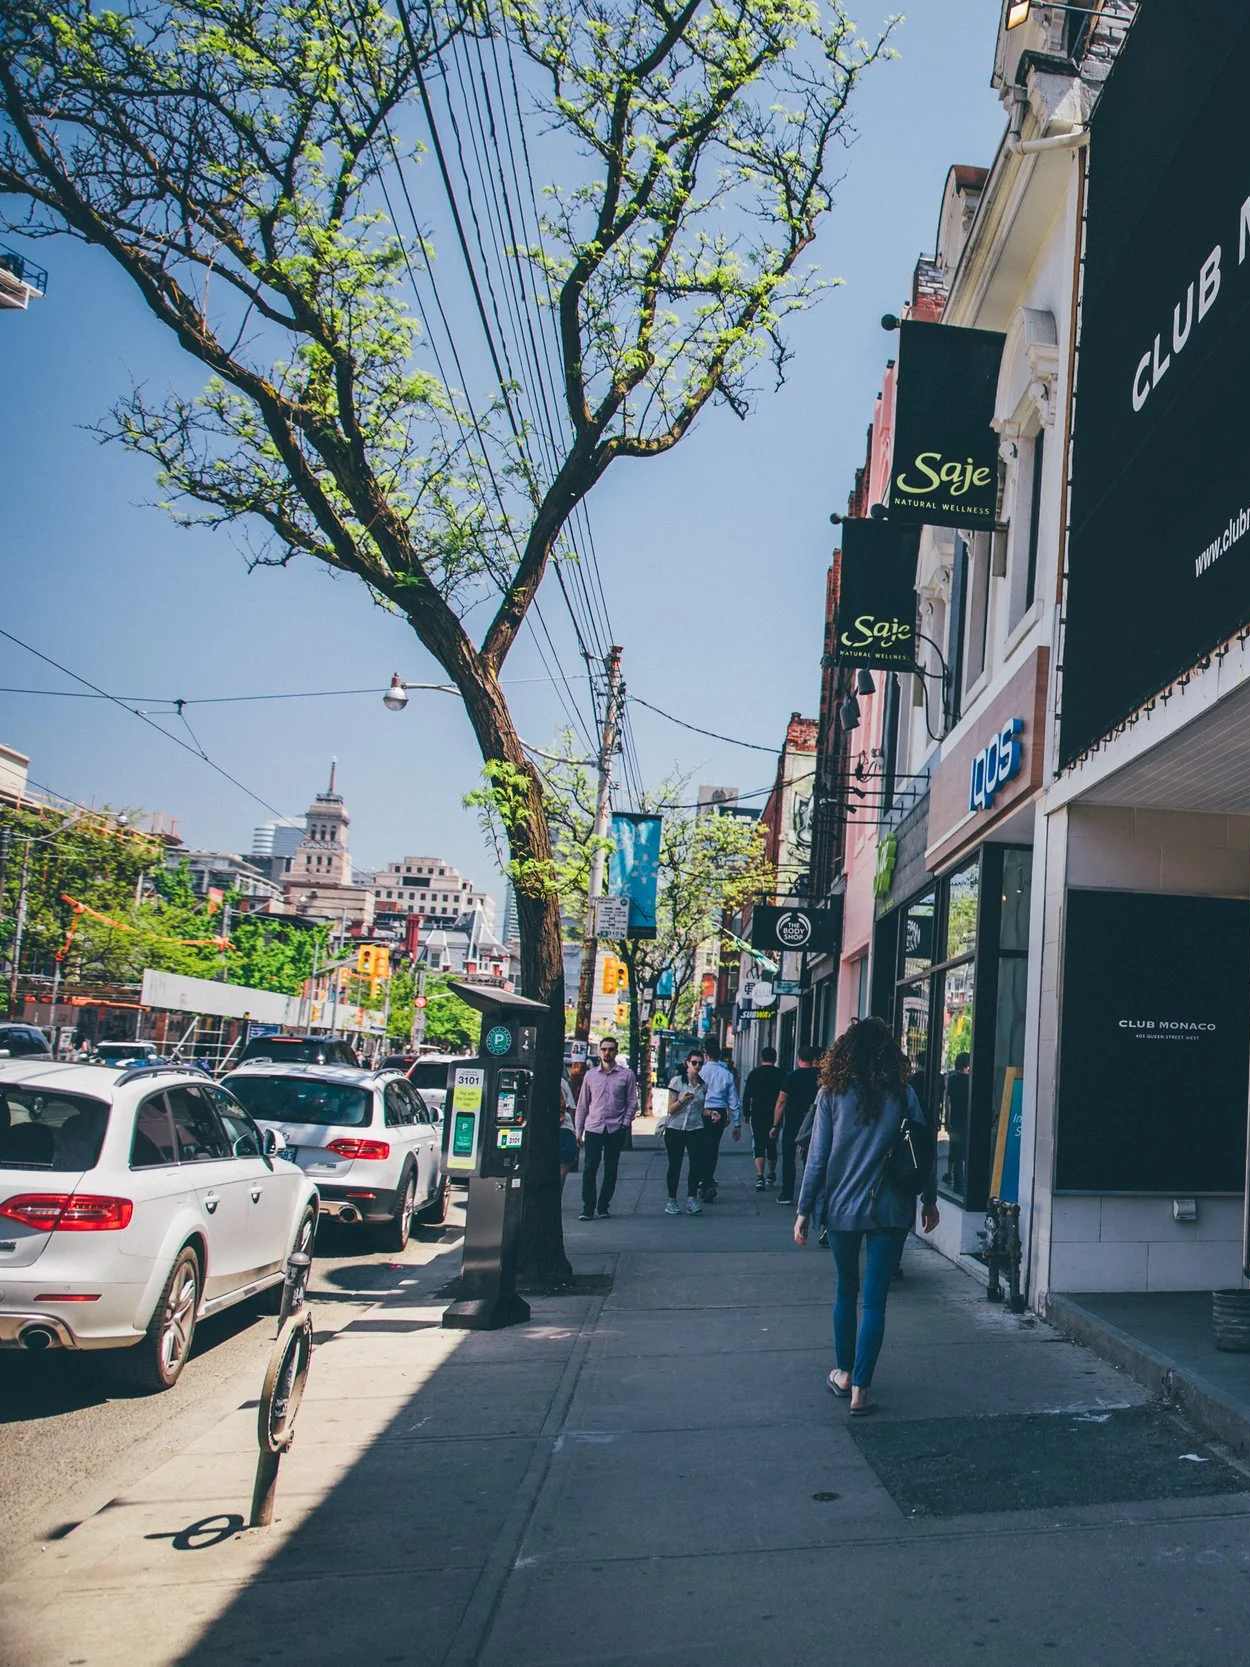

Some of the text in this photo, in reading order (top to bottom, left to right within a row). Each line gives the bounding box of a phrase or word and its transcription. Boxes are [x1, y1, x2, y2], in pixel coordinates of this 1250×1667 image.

[1132, 244, 1221, 412] CLUB
[896, 452, 992, 496] Saje
[894, 498, 990, 515] NATURAL WELLNESS
[841, 615, 912, 648] Saje
[839, 650, 871, 658] NATURAL
[740, 1011, 776, 1019] SUBWAY
[1118, 1020, 1216, 1031] CLUB MONACO
[494, 1033, 505, 1045] P
[458, 1076, 480, 1085] 3101
